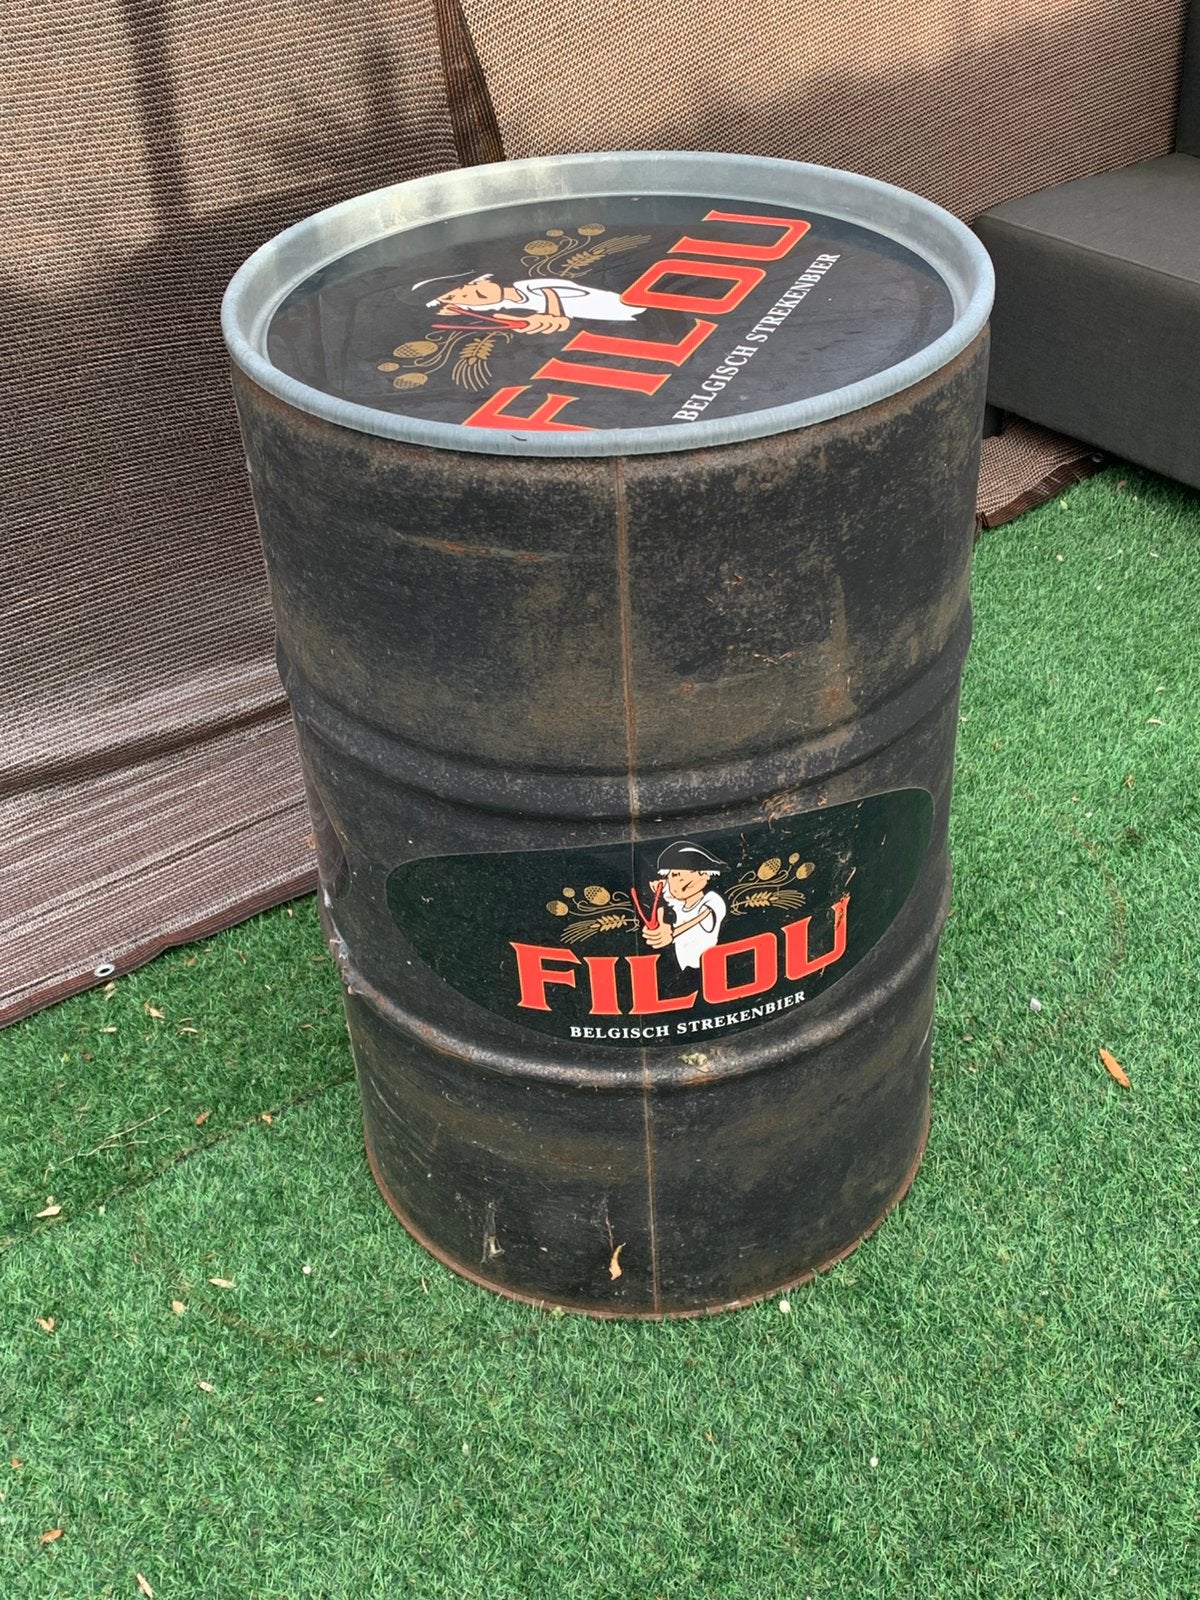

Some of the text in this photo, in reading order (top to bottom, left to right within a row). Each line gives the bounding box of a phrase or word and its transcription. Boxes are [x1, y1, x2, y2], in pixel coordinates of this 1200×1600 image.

[462, 209, 812, 432] FILOU
[672, 251, 841, 422] BELGISCH STREKENBIER
[508, 894, 851, 1016] FILOU
[569, 990, 806, 1040] BELGISCH STREKENBIER
